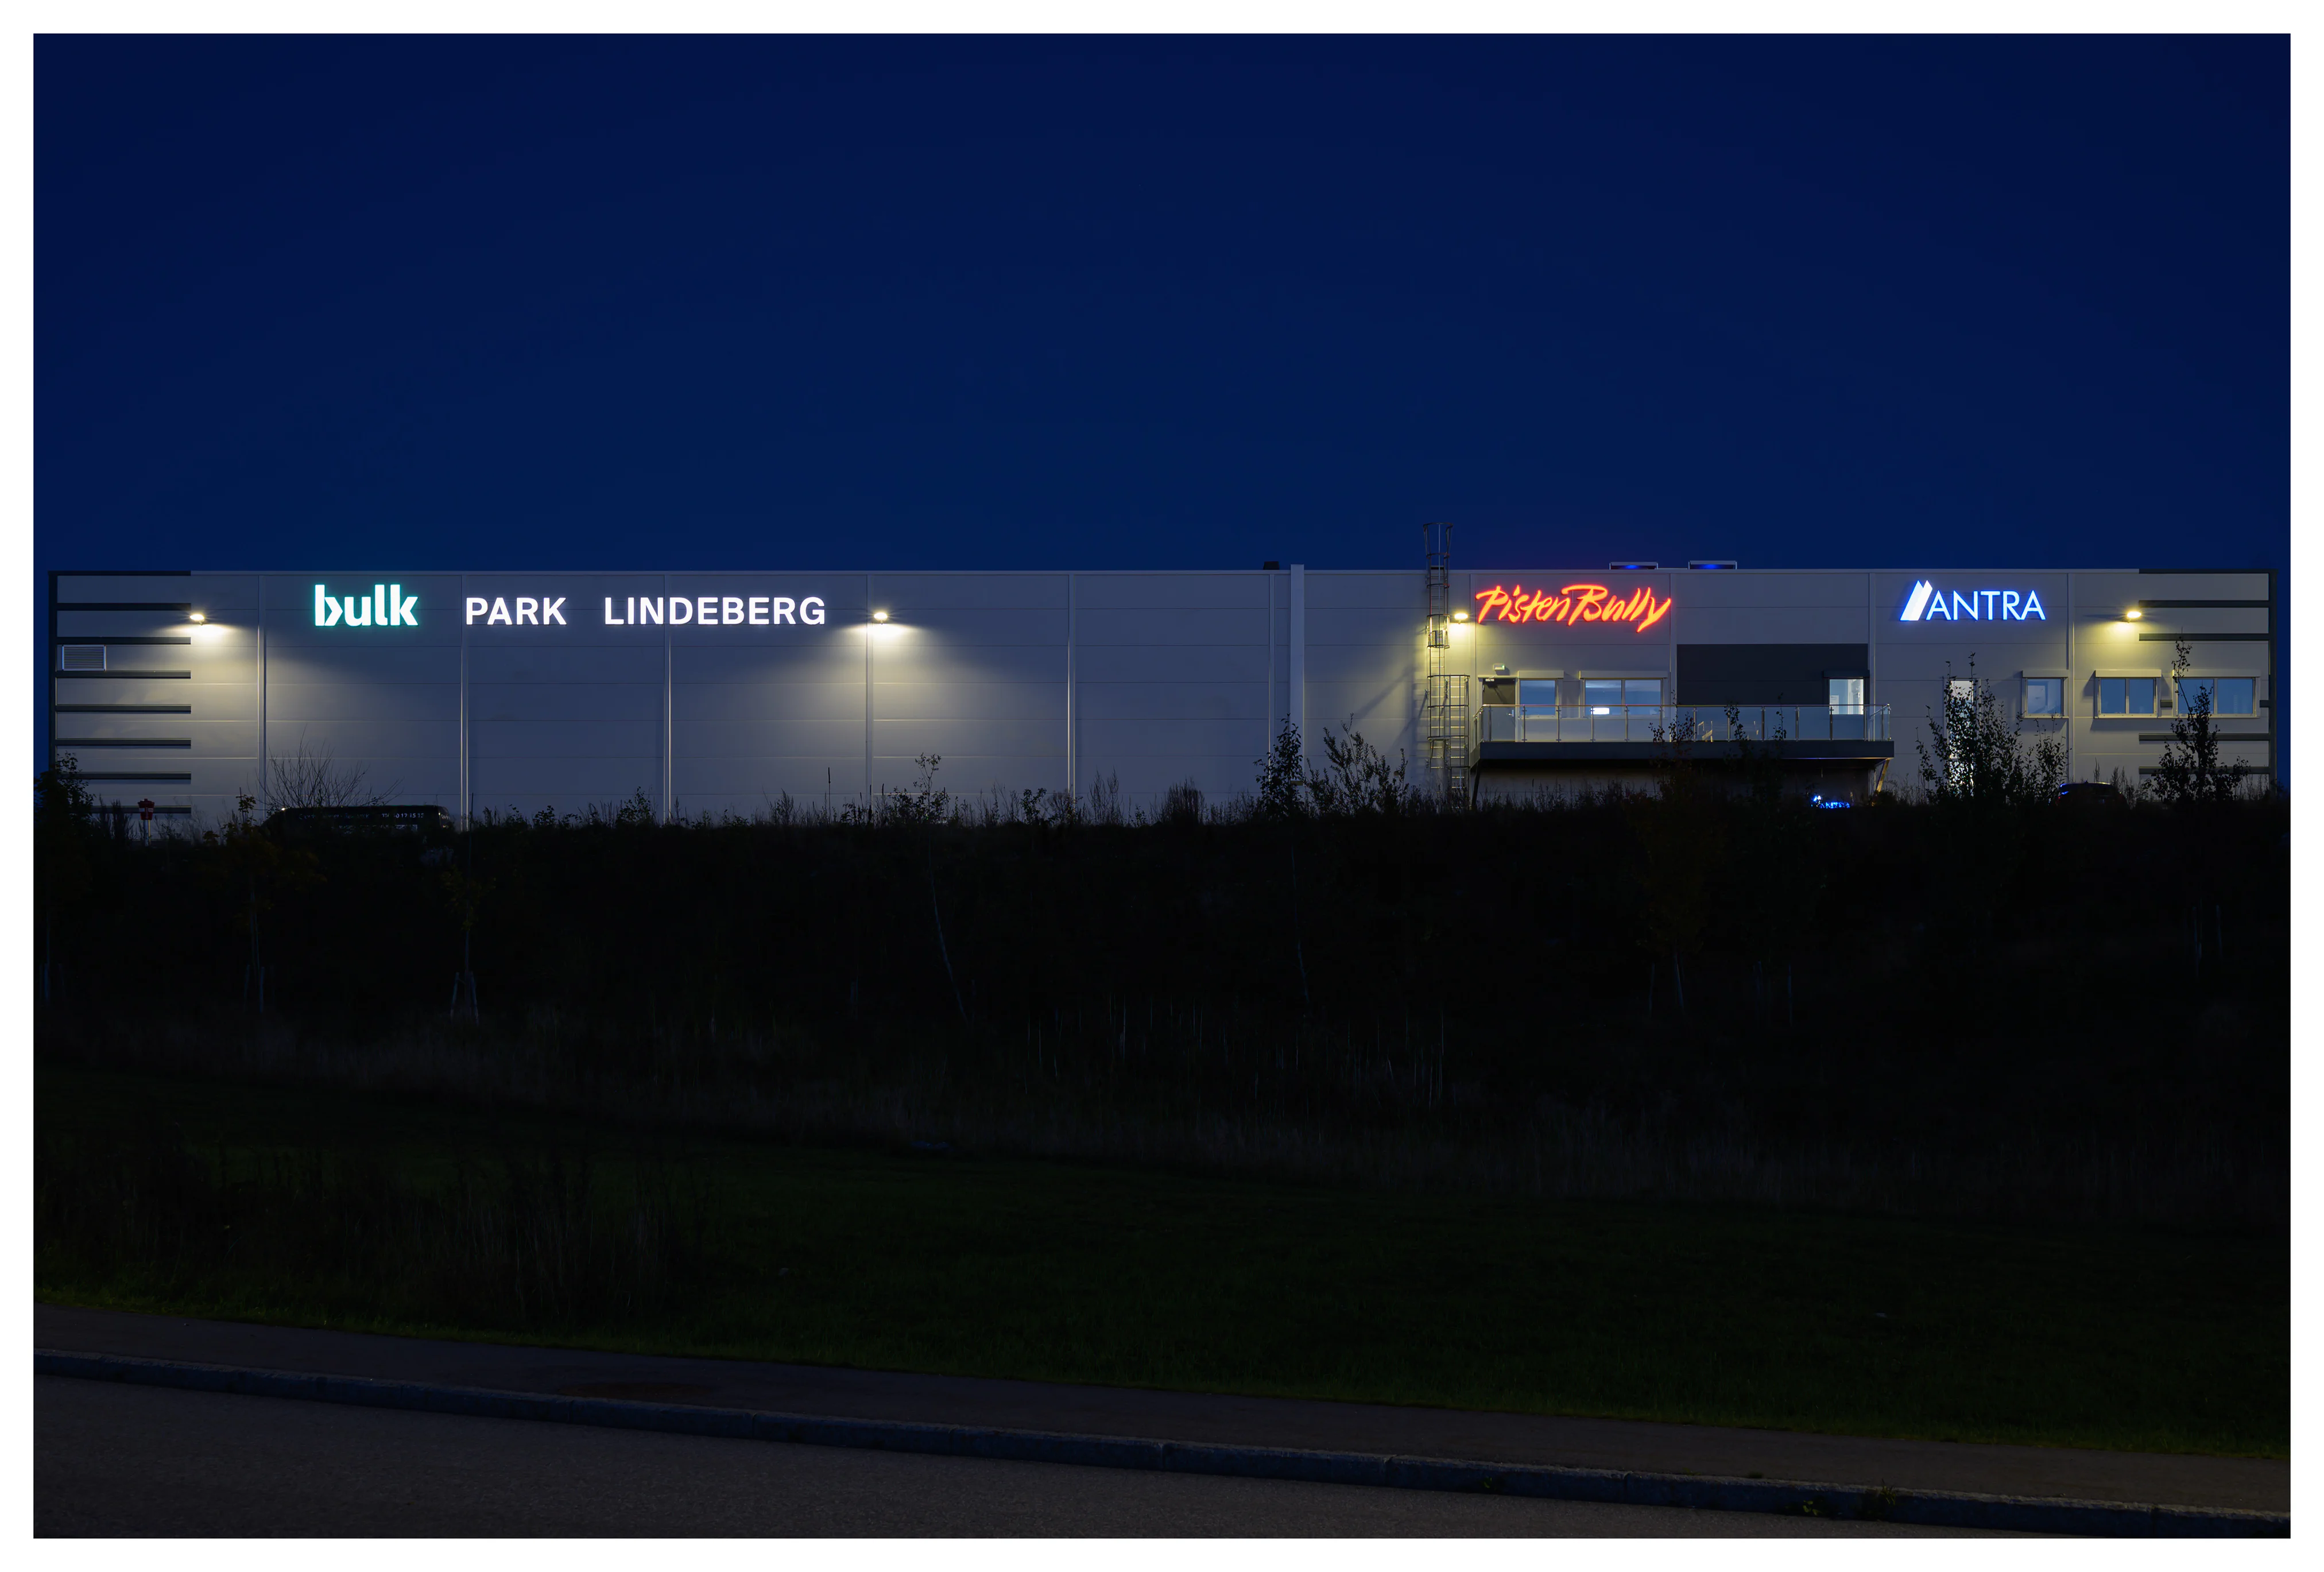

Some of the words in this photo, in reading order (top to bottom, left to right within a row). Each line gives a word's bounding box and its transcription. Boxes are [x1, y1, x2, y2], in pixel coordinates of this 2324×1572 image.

[314, 584, 419, 627] bulk
[466, 597, 567, 625] PARK
[605, 596, 825, 625] LINDEBERG
[1475, 584, 1672, 633] PistenBully
[1926, 590, 2046, 621] ANTRA
